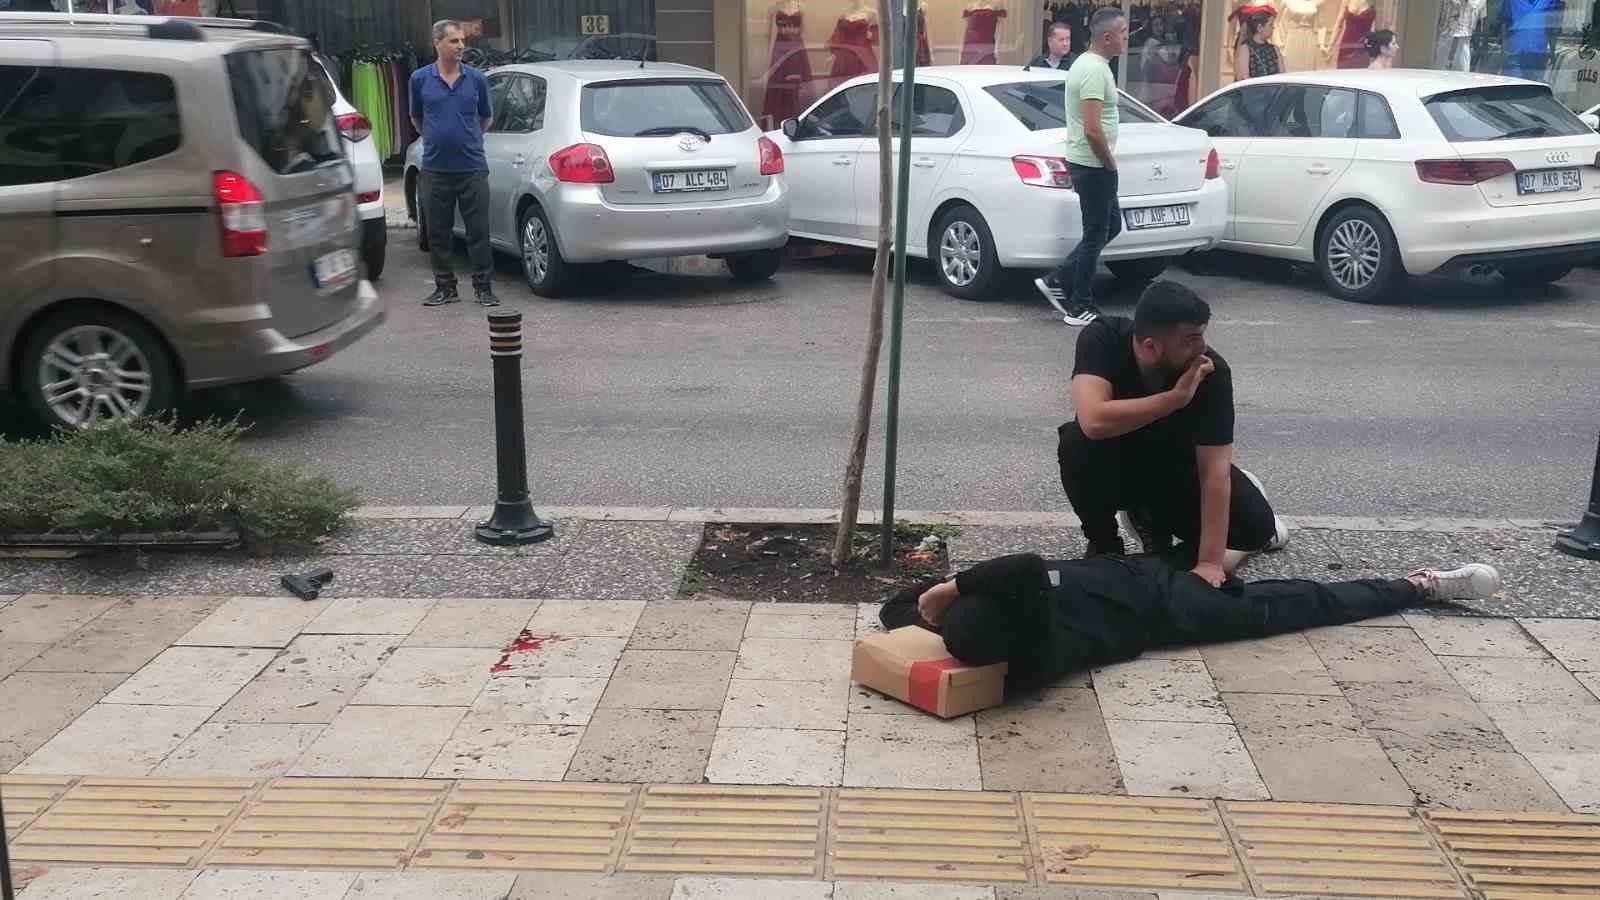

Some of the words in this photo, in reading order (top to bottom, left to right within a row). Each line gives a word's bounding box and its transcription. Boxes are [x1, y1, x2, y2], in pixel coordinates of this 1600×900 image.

[662, 174, 675, 188] 07
[686, 172, 705, 187] ALC
[707, 172, 726, 186] 484
[1525, 174, 1536, 188] 07
[1543, 172, 1559, 186] AKB
[1562, 171, 1578, 185] 654
[1134, 208, 1145, 224] 07
